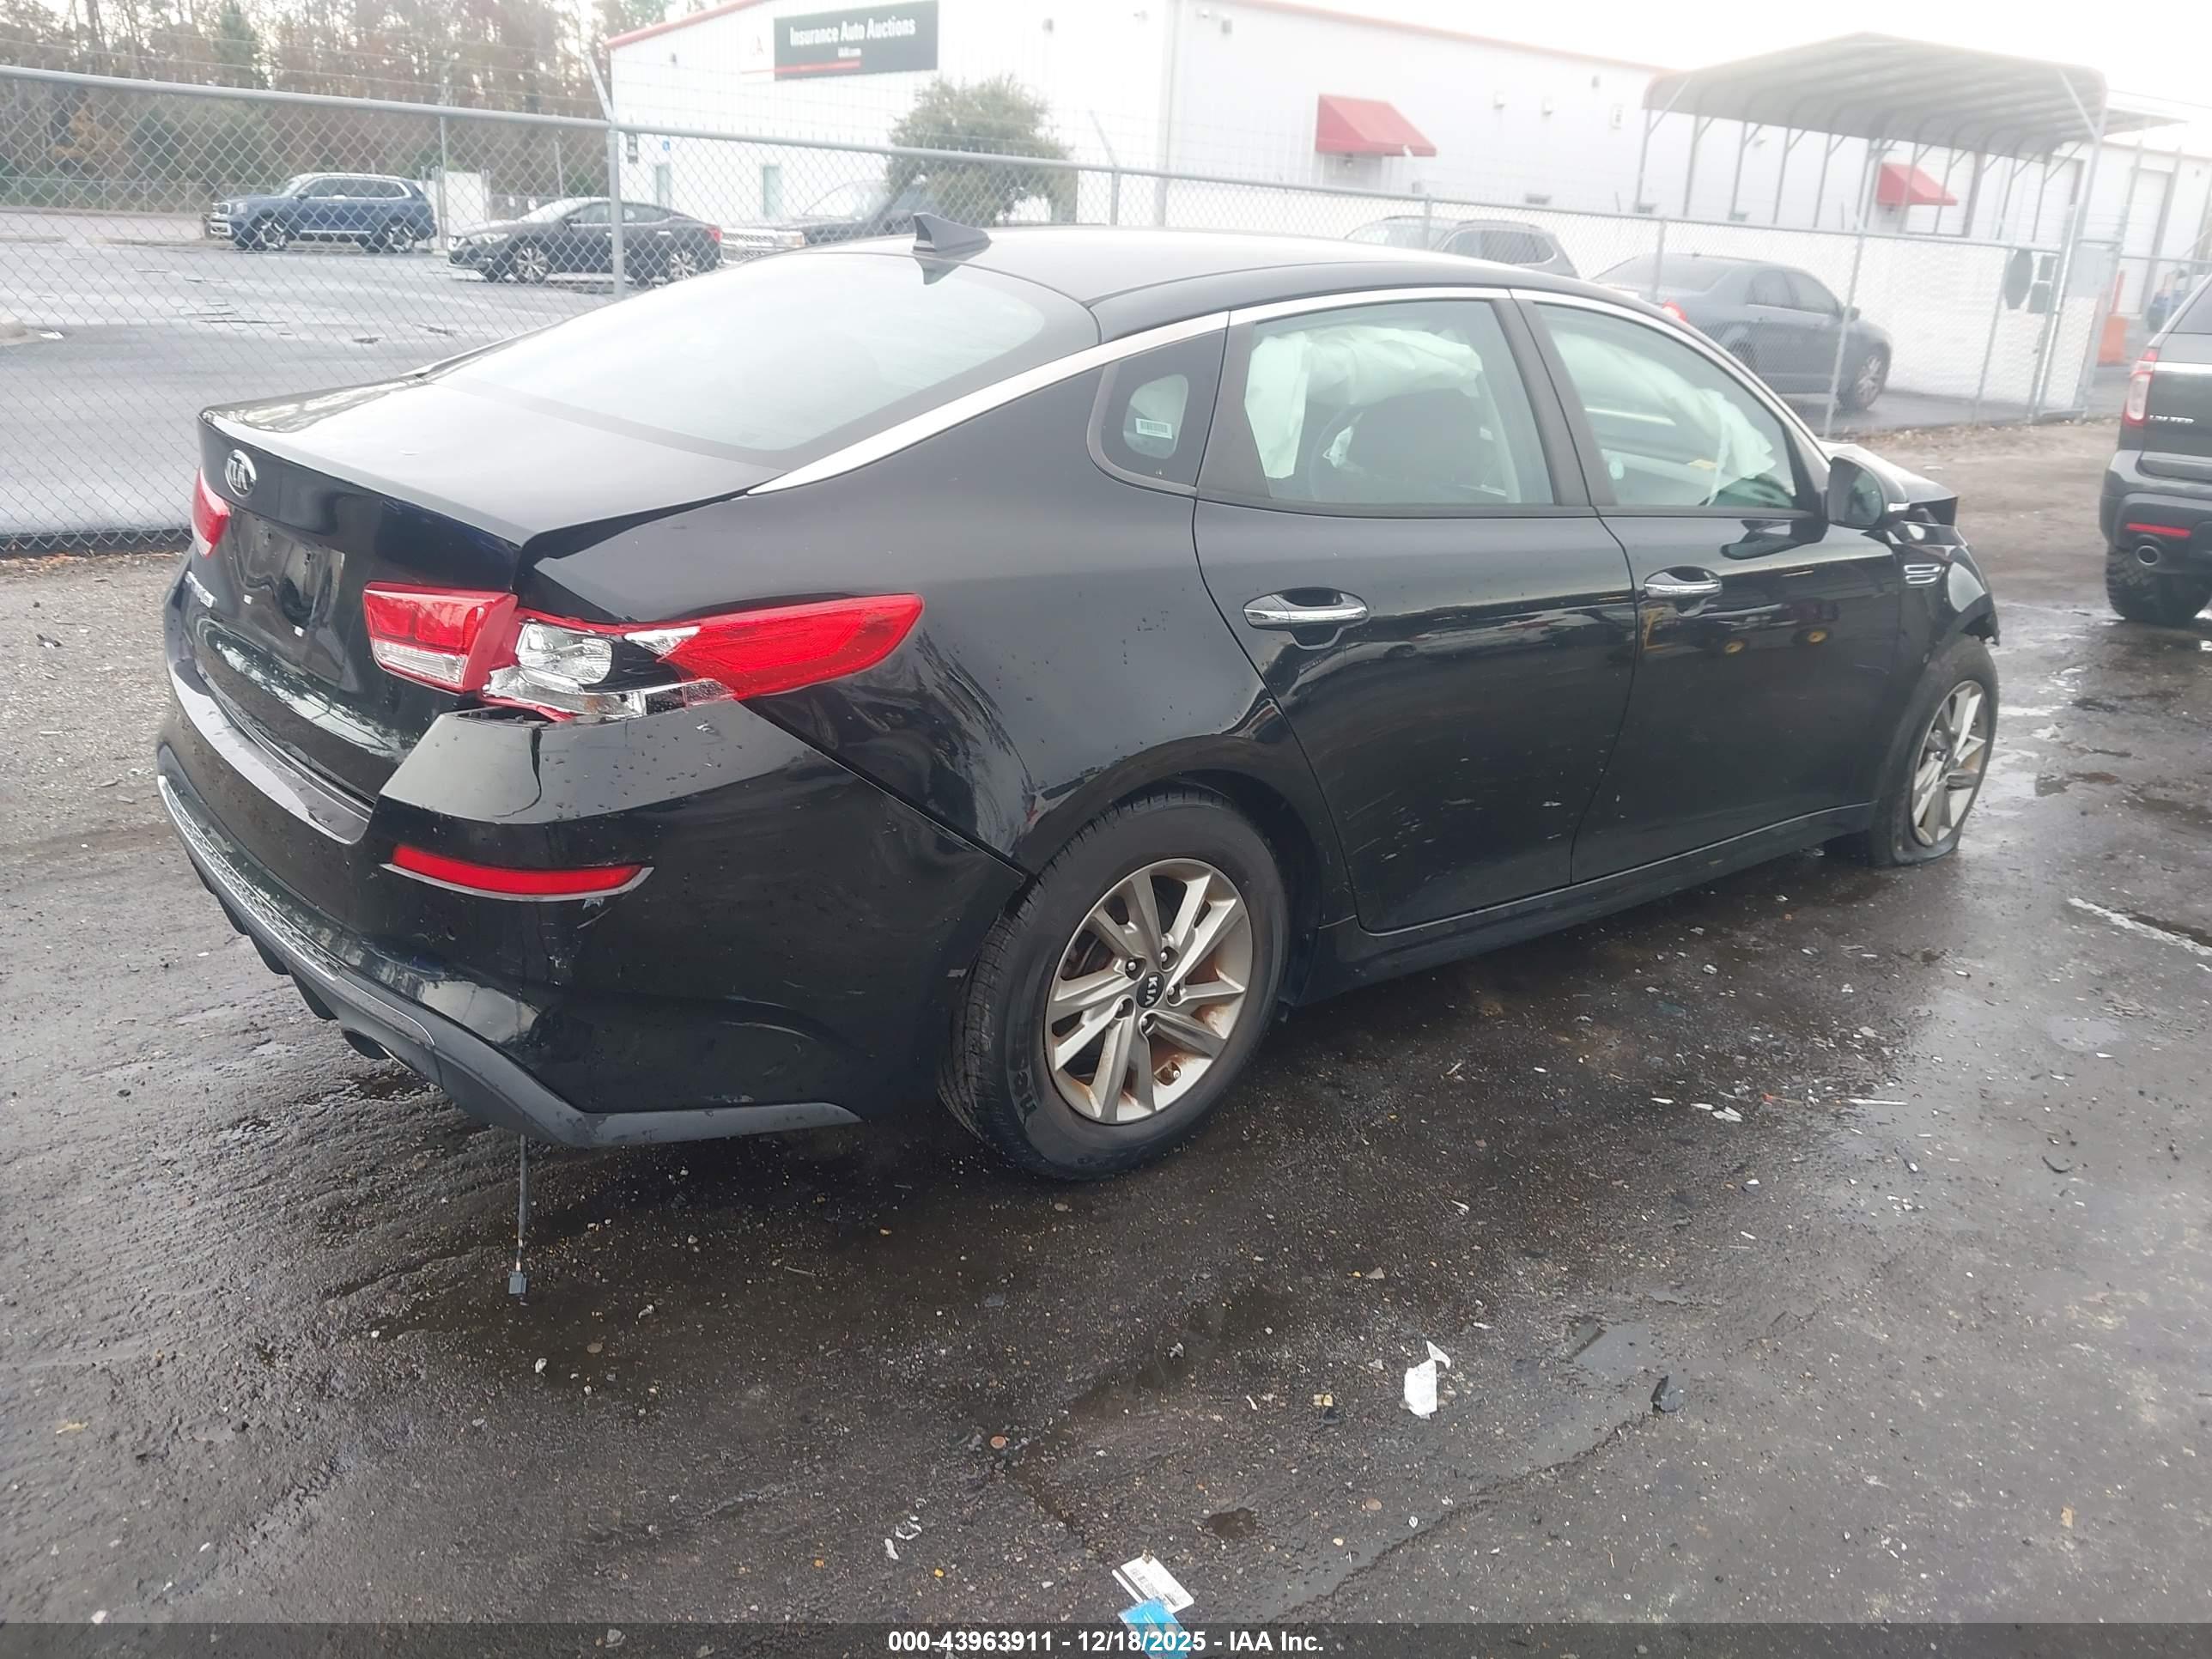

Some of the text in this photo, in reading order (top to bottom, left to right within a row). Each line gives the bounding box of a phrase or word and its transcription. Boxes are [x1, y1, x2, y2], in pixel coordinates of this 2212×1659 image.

[789, 15, 916, 46] Insurance Auto Auctions
[1145, 975, 1158, 1006] KIA
